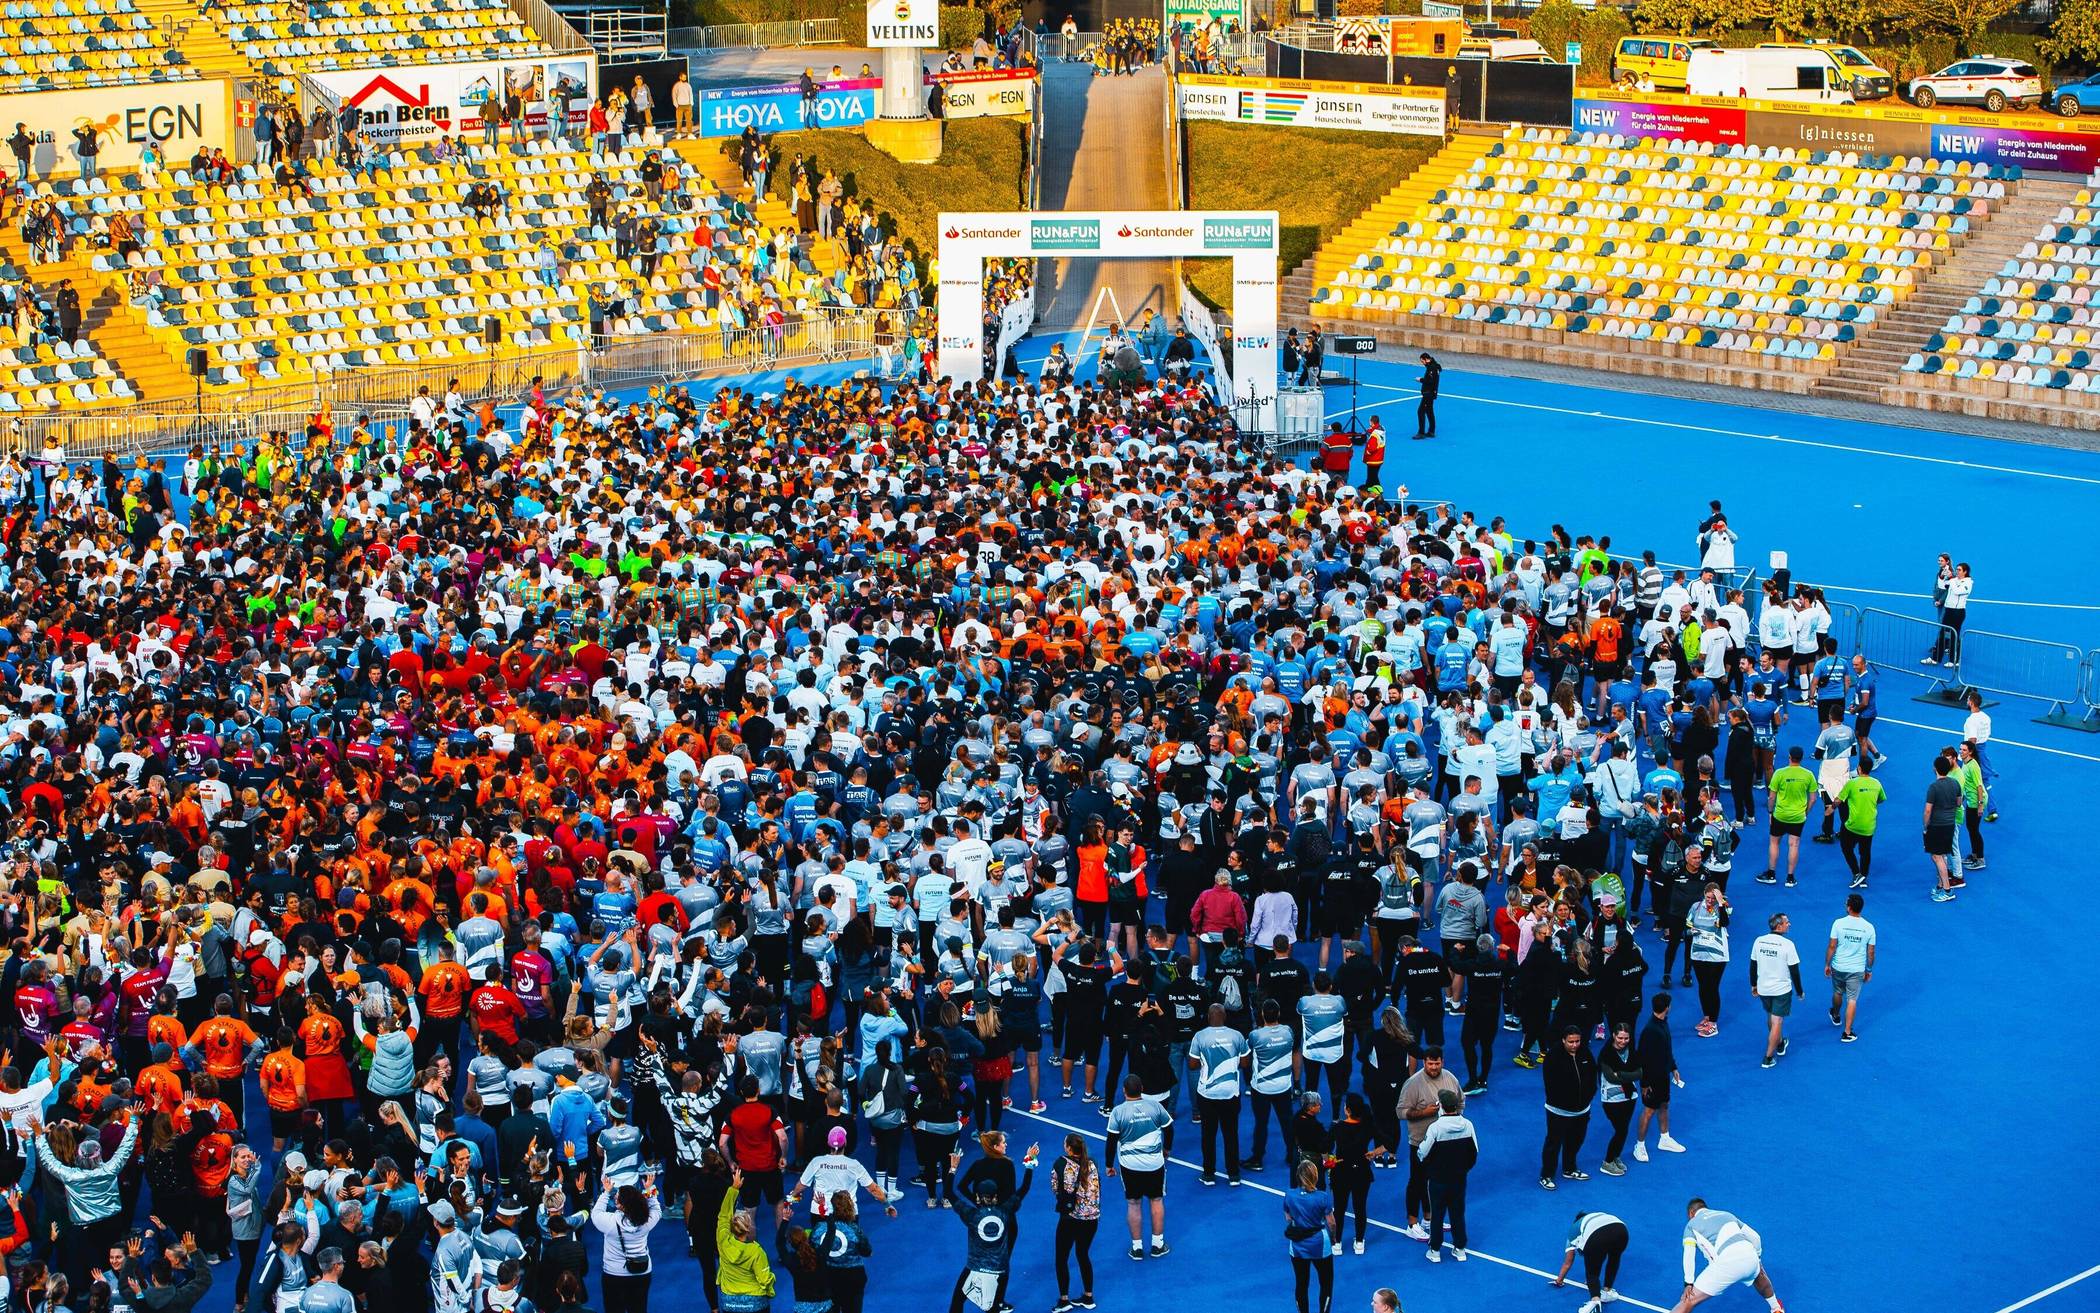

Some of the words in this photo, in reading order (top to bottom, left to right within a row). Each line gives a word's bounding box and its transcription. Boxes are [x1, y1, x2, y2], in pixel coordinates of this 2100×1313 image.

[872, 25, 935, 39] VELTINS
[951, 93, 975, 107] EGN
[1001, 90, 1024, 103] EGN
[396, 103, 450, 123] Bern
[1392, 103, 1401, 111] Ihr
[1402, 104, 1429, 112] Partner
[1429, 105, 1440, 113] für
[711, 102, 784, 130] HOYA
[1314, 115, 1362, 125] Haustechnik
[1372, 112, 1398, 121] Energie
[1631, 112, 1656, 121] Energie
[1671, 114, 1710, 124] Niederrhein
[126, 103, 203, 144] EGN
[1642, 123, 1656, 131] dein
[1658, 123, 1685, 132] Zuhause
[1800, 124, 1875, 143] [g]niessen
[1997, 138, 2026, 149] Energie
[2043, 141, 2087, 152] Niederrhein
[1997, 148, 2009, 157] für
[2010, 149, 2026, 158] dein
[2027, 151, 2058, 161] Zuhause
[961, 228, 1022, 239] Santander
[1033, 226, 1098, 238] RUN&FUN
[1134, 226, 1195, 238] Santander
[1205, 225, 1271, 238] RUN&FUN
[978, 551, 994, 564] 38
[1760, 948, 1778, 956] FUTURE
[134, 980, 148, 988] TEAM
[148, 976, 164, 985] FREUDE
